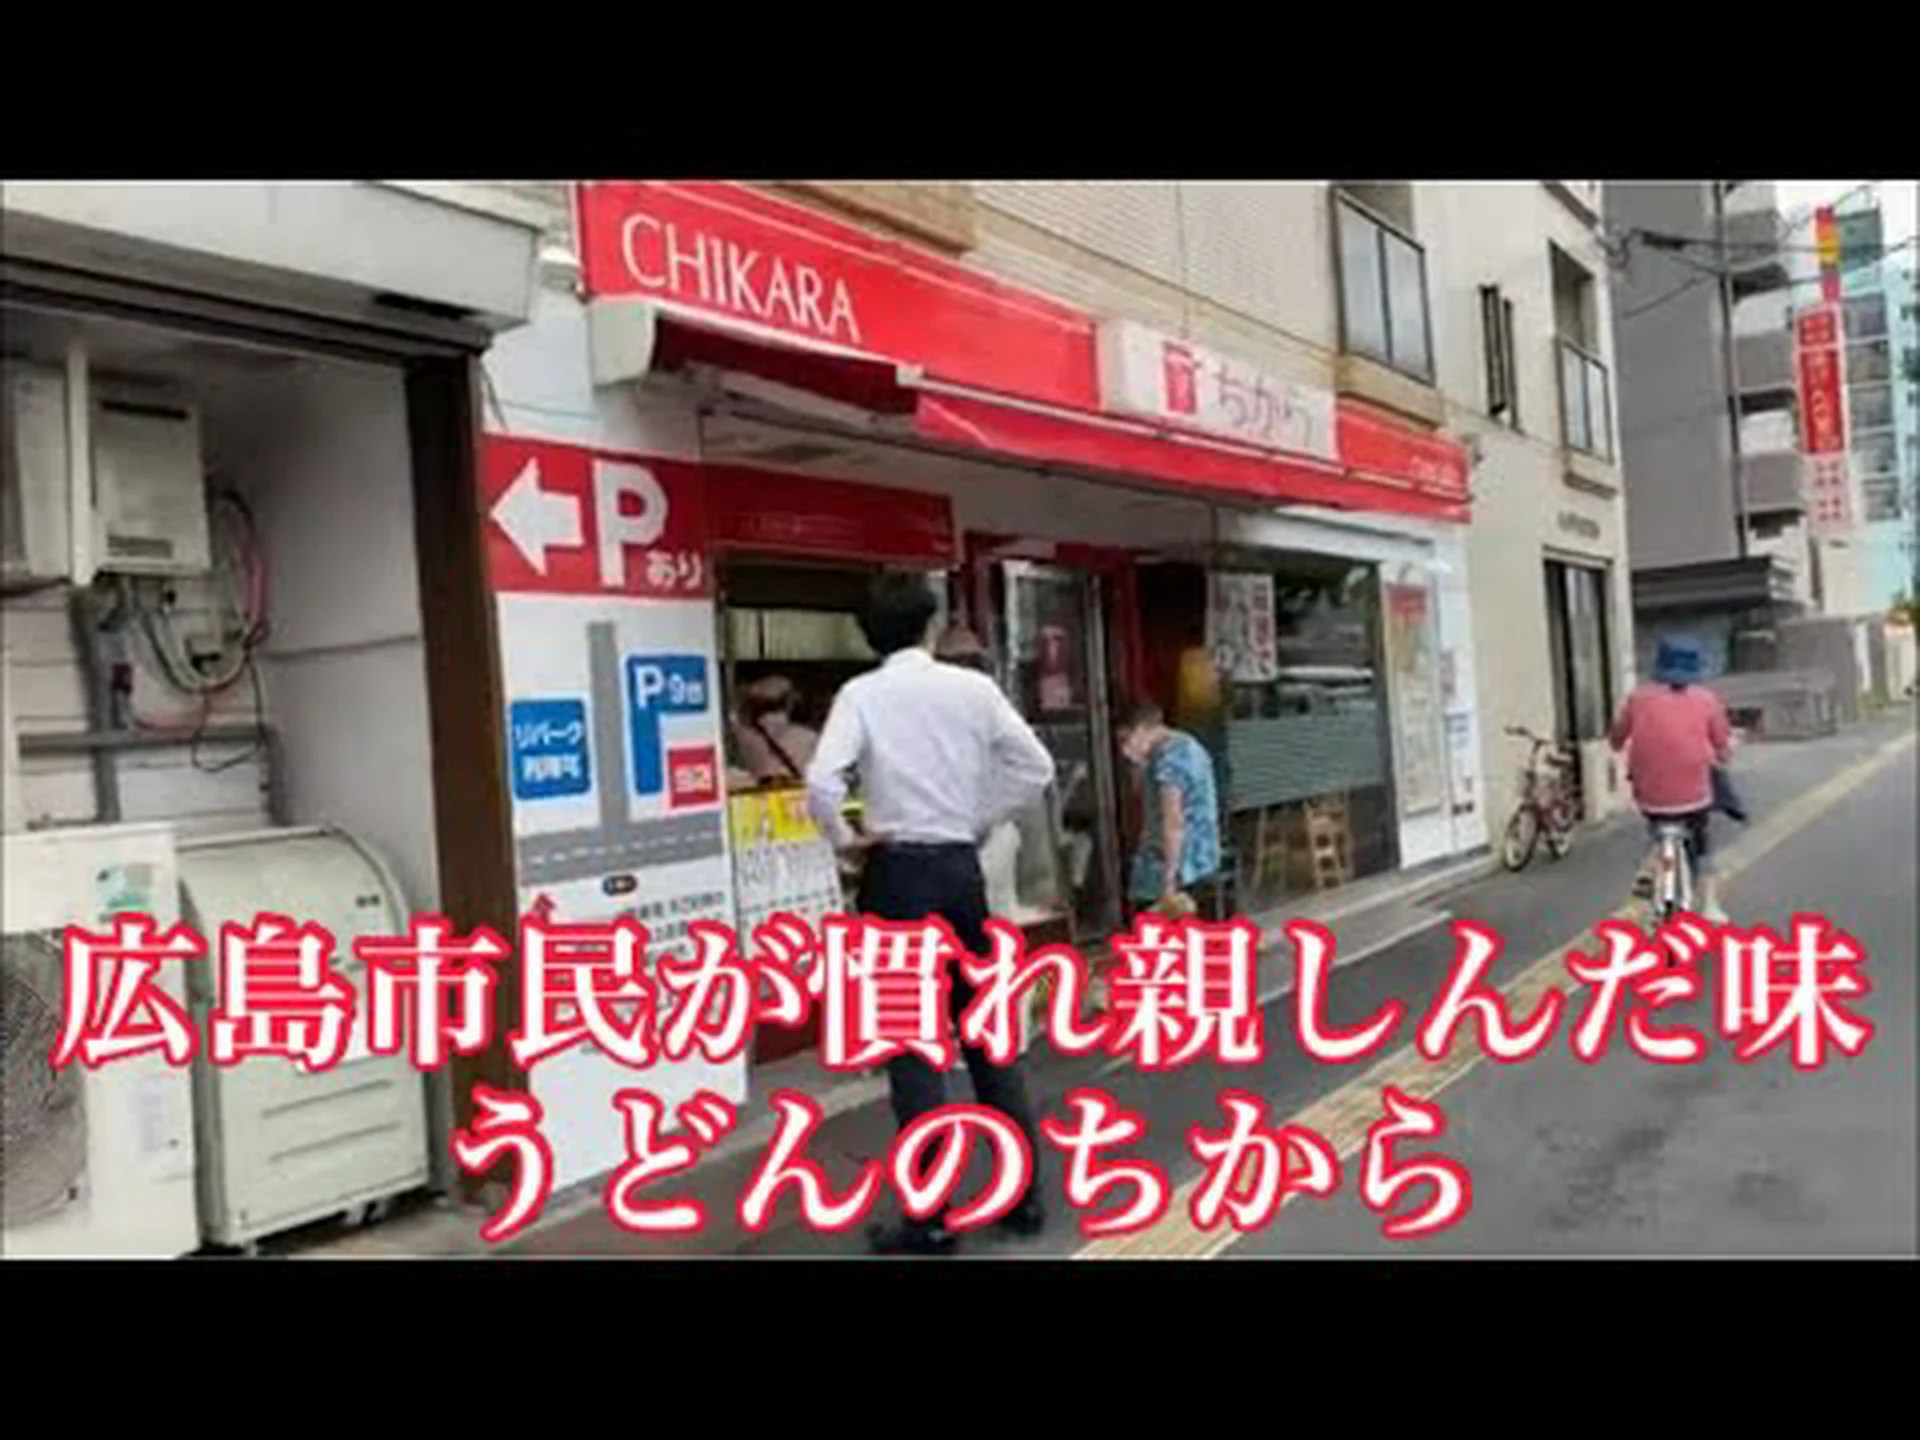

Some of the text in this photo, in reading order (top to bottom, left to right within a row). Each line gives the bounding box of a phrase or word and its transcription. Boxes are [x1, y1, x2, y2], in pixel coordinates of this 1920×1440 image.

[621, 212, 862, 344] CHIKARA
[594, 460, 669, 587] P
[646, 548, 702, 590] あり
[634, 664, 665, 709] P
